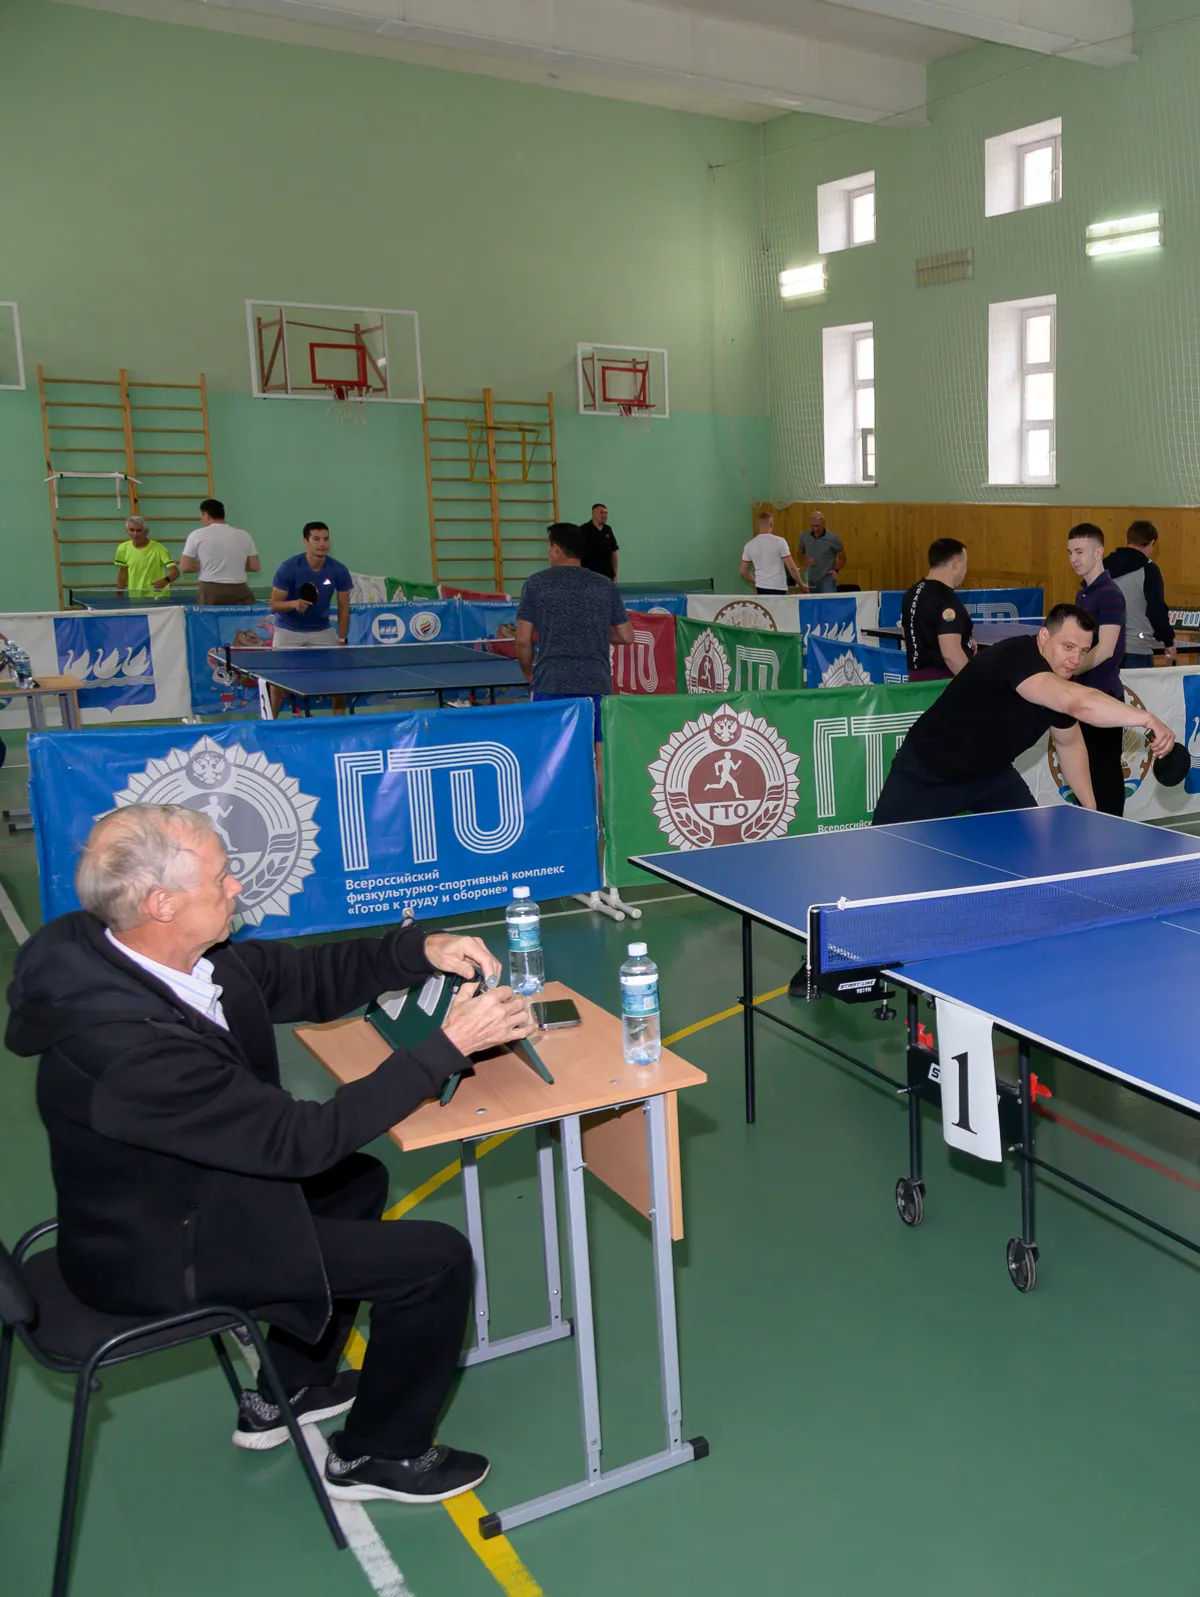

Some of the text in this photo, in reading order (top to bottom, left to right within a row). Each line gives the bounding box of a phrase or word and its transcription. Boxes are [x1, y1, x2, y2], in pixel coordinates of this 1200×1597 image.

[334, 740, 524, 872] ГТО
[708, 803, 750, 820] ГТО
[818, 820, 872, 834] Всероссийск
[345, 870, 440, 890] Всероссийский
[346, 865, 565, 904] физкультурно-спортивный комплекс
[347, 886, 508, 916] «Готов к труду и обороне»
[951, 1052, 978, 1135] 1
